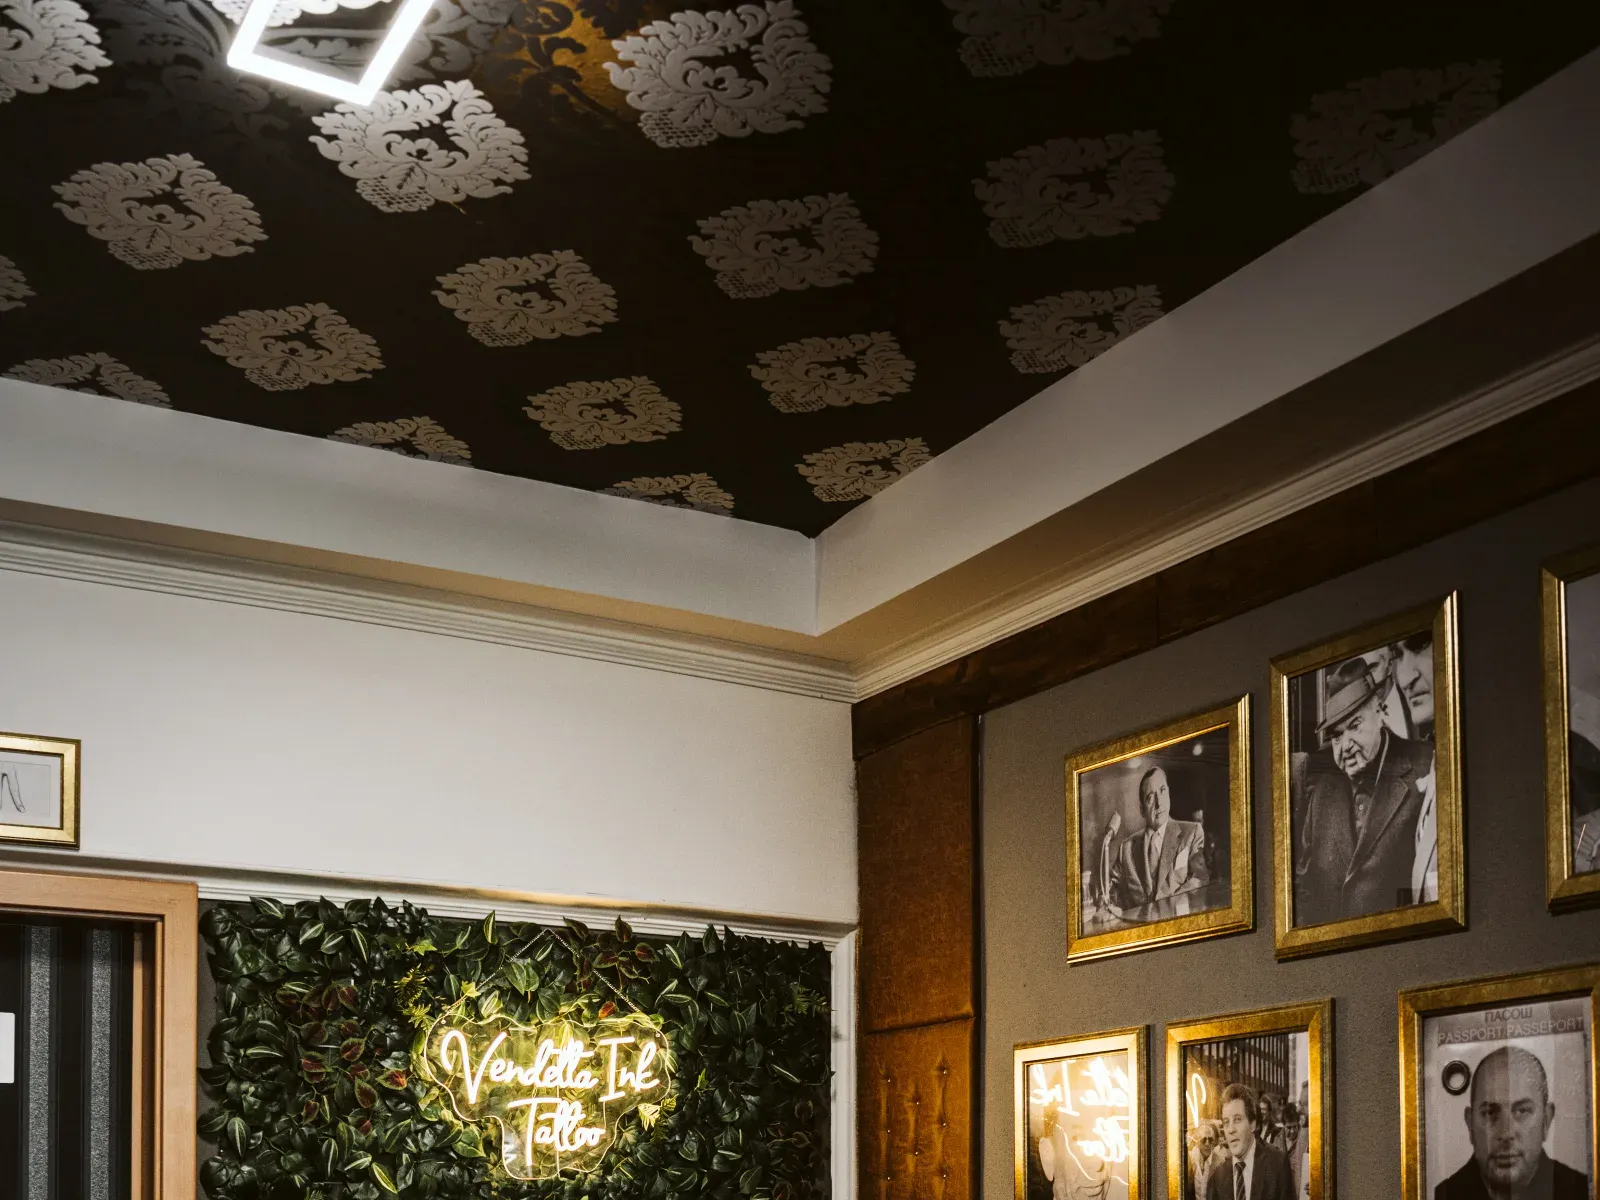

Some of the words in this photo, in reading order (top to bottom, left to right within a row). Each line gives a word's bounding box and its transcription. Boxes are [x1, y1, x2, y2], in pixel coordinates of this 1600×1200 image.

[1484, 1006, 1532, 1023] ПАСОШ
[1506, 1016, 1584, 1037] PASSEPORT
[441, 1030, 597, 1104] Vendetta
[599, 1035, 660, 1102] Ink
[508, 1097, 606, 1167] Tattoo
